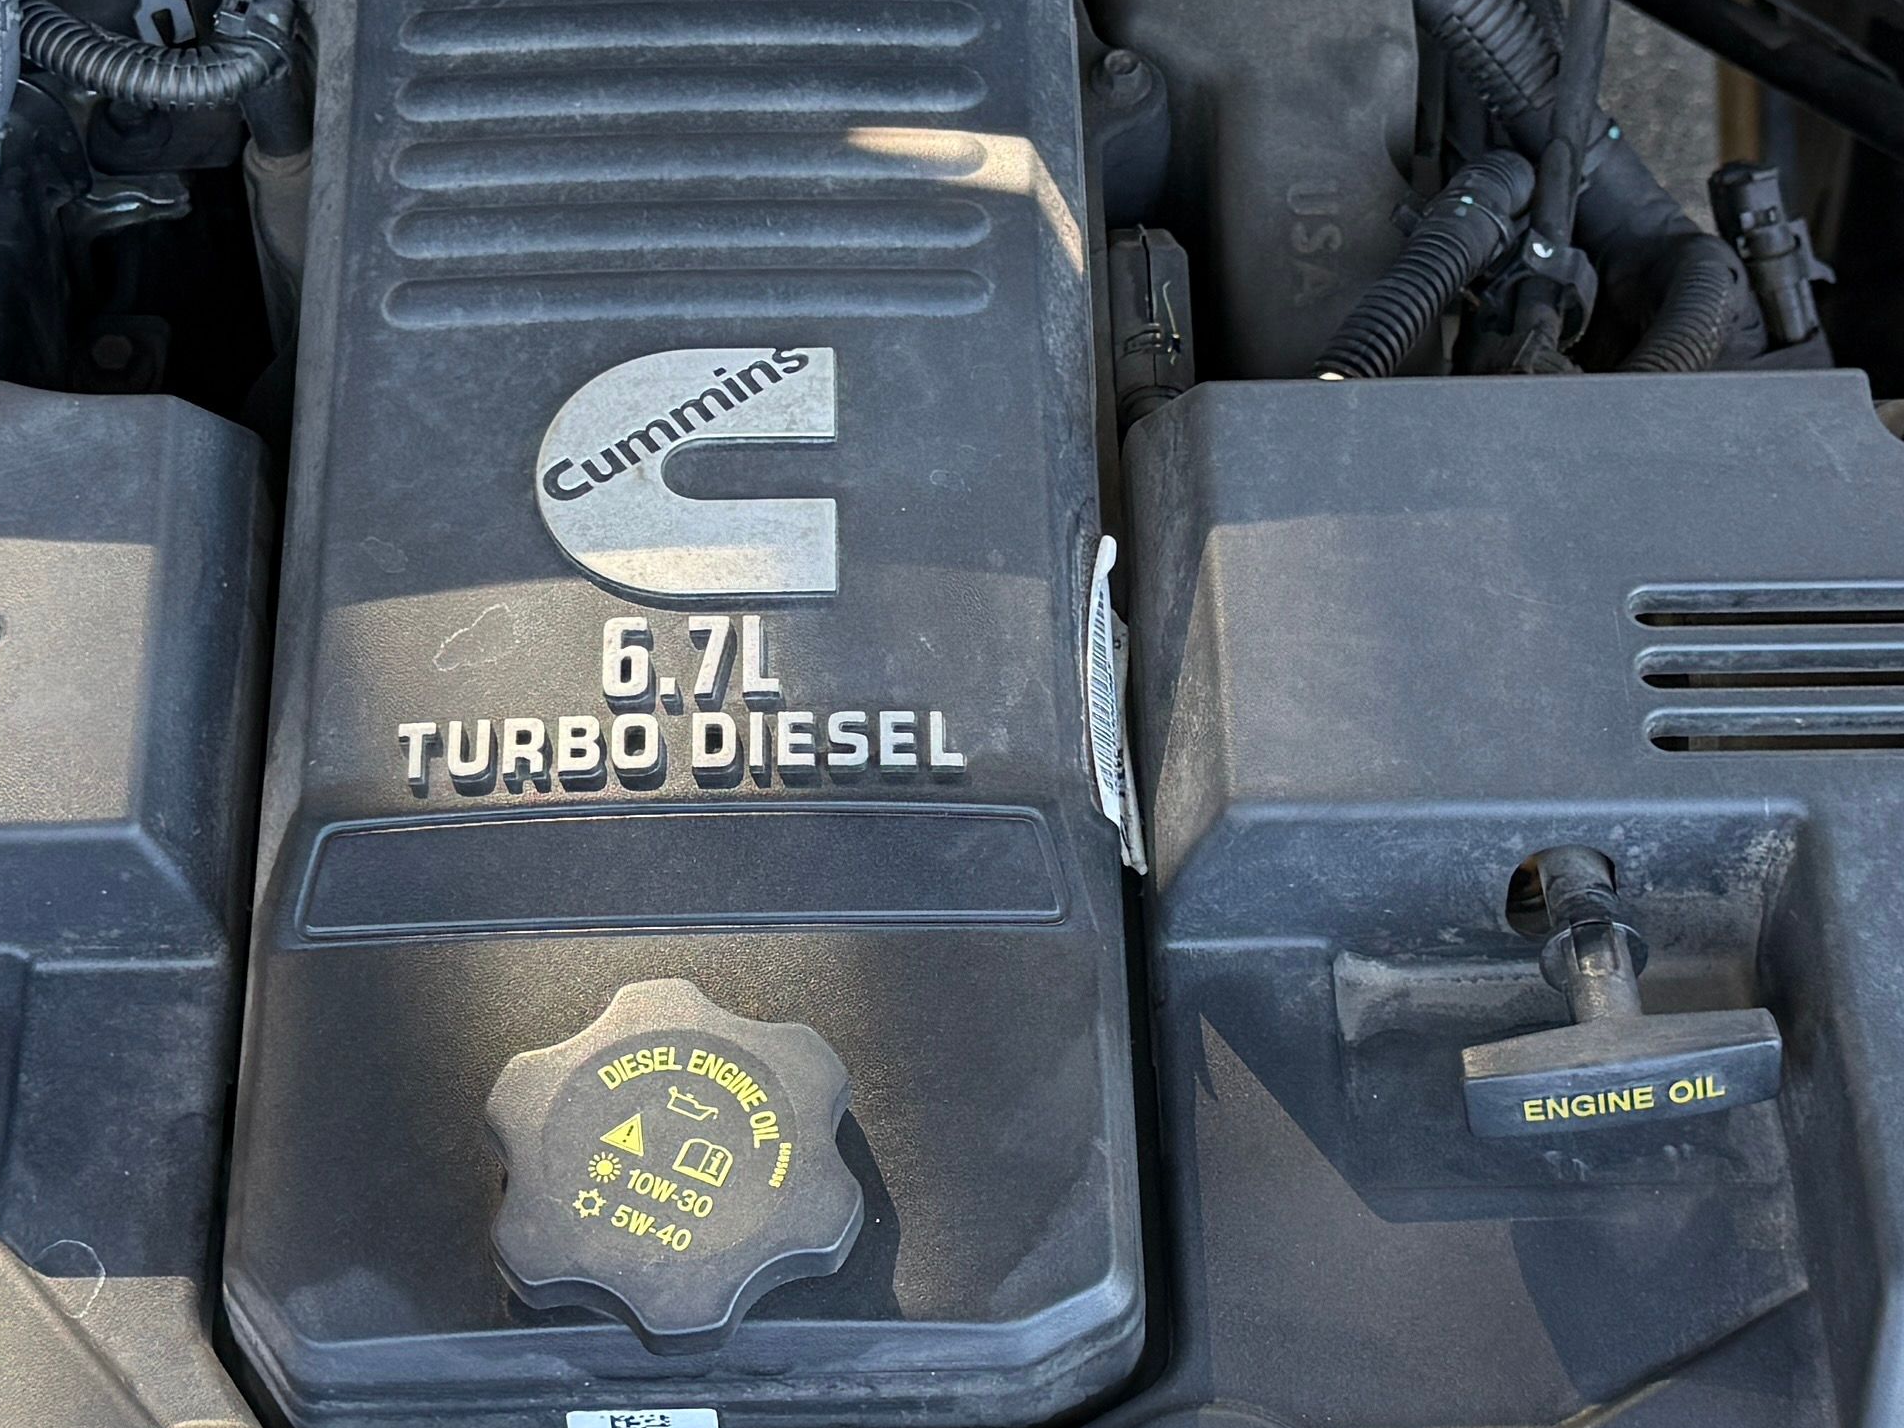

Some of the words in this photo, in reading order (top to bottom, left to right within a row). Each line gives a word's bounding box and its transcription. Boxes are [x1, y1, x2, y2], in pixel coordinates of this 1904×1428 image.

[1286, 179, 1344, 307] USA
[542, 346, 810, 502] Cummins
[602, 615, 782, 700] 6.7L
[398, 712, 660, 779] TURBO
[692, 710, 966, 772] DIESEL
[597, 1046, 683, 1091] DIESEL
[686, 1048, 768, 1113] ENGINE
[749, 1110, 780, 1149] OIL
[1522, 1085, 1655, 1123] ENGINE
[1668, 1075, 1726, 1104] OIL
[610, 1203, 693, 1252] 5W-40
[627, 1168, 713, 1219] 10W-30
